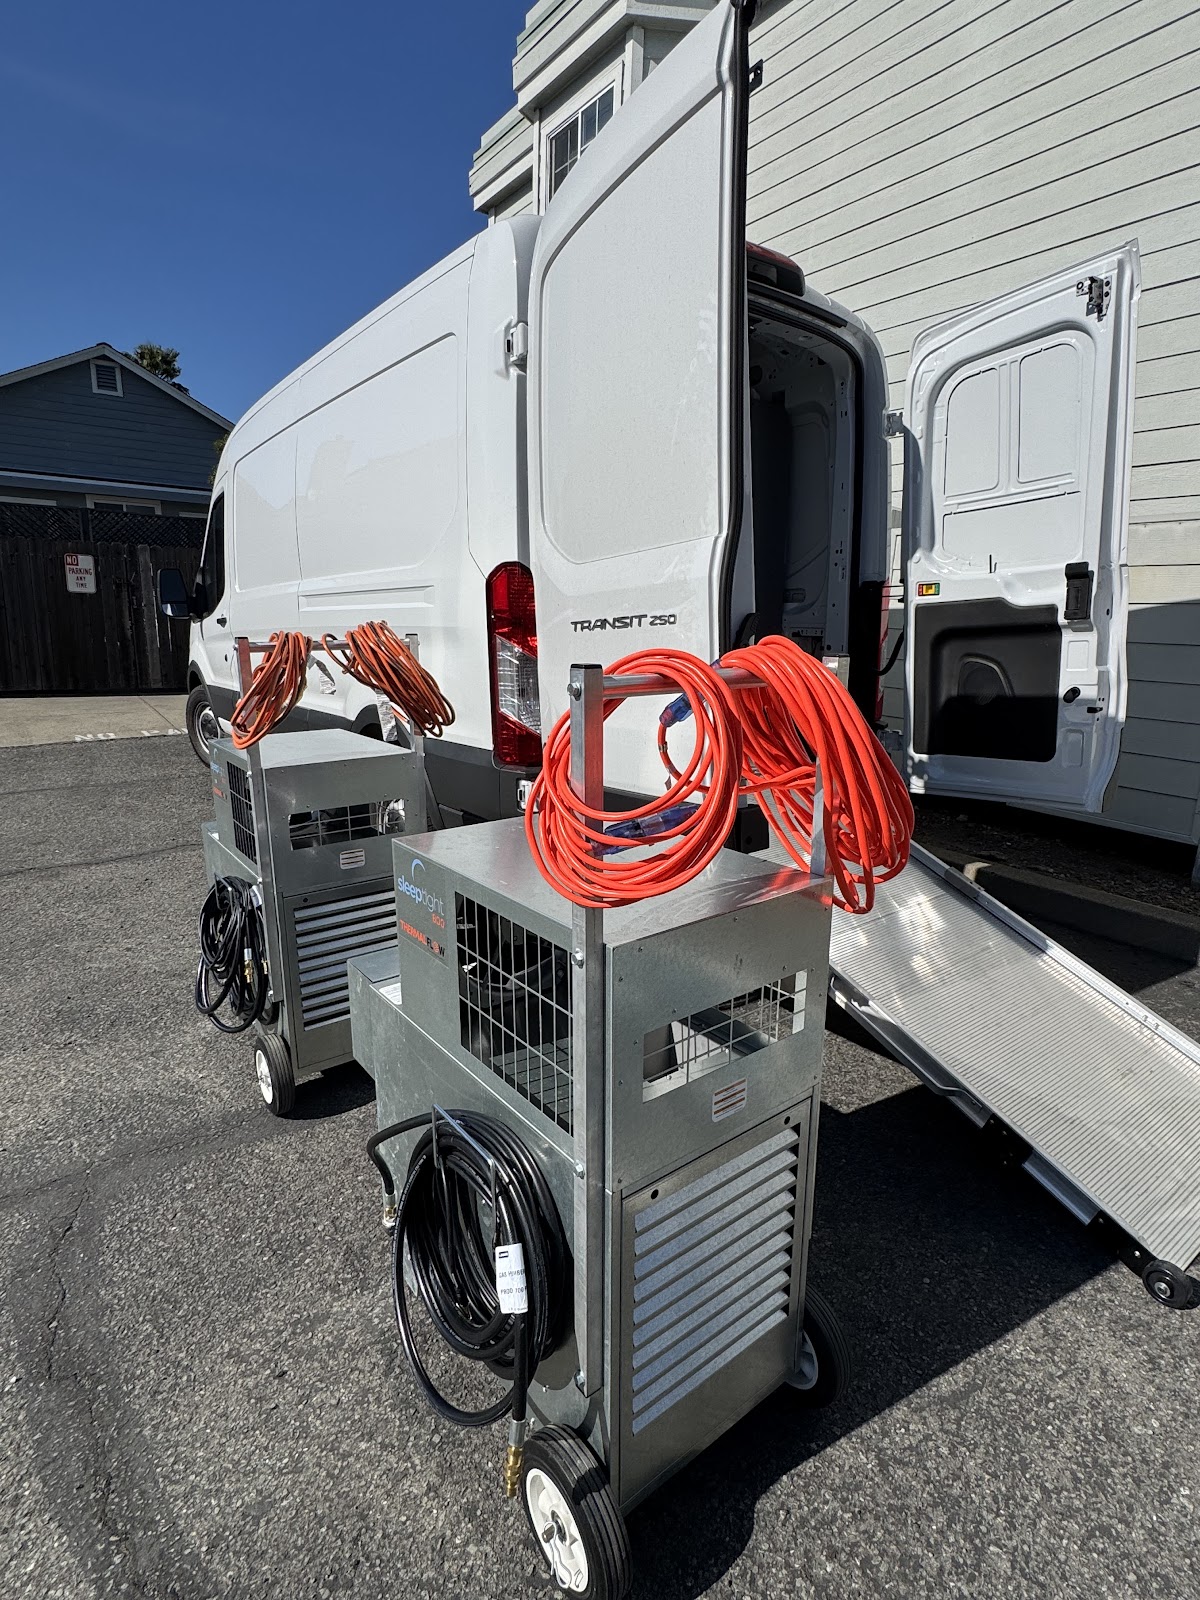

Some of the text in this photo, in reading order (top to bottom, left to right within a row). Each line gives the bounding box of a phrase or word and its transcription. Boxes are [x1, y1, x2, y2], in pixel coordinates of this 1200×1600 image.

[66, 555, 77, 564] NO
[68, 567, 92, 575] PARKING
[570, 613, 677, 632] TRANSIT 250
[74, 732, 116, 742] NO
[397, 874, 445, 916] sleeptight
